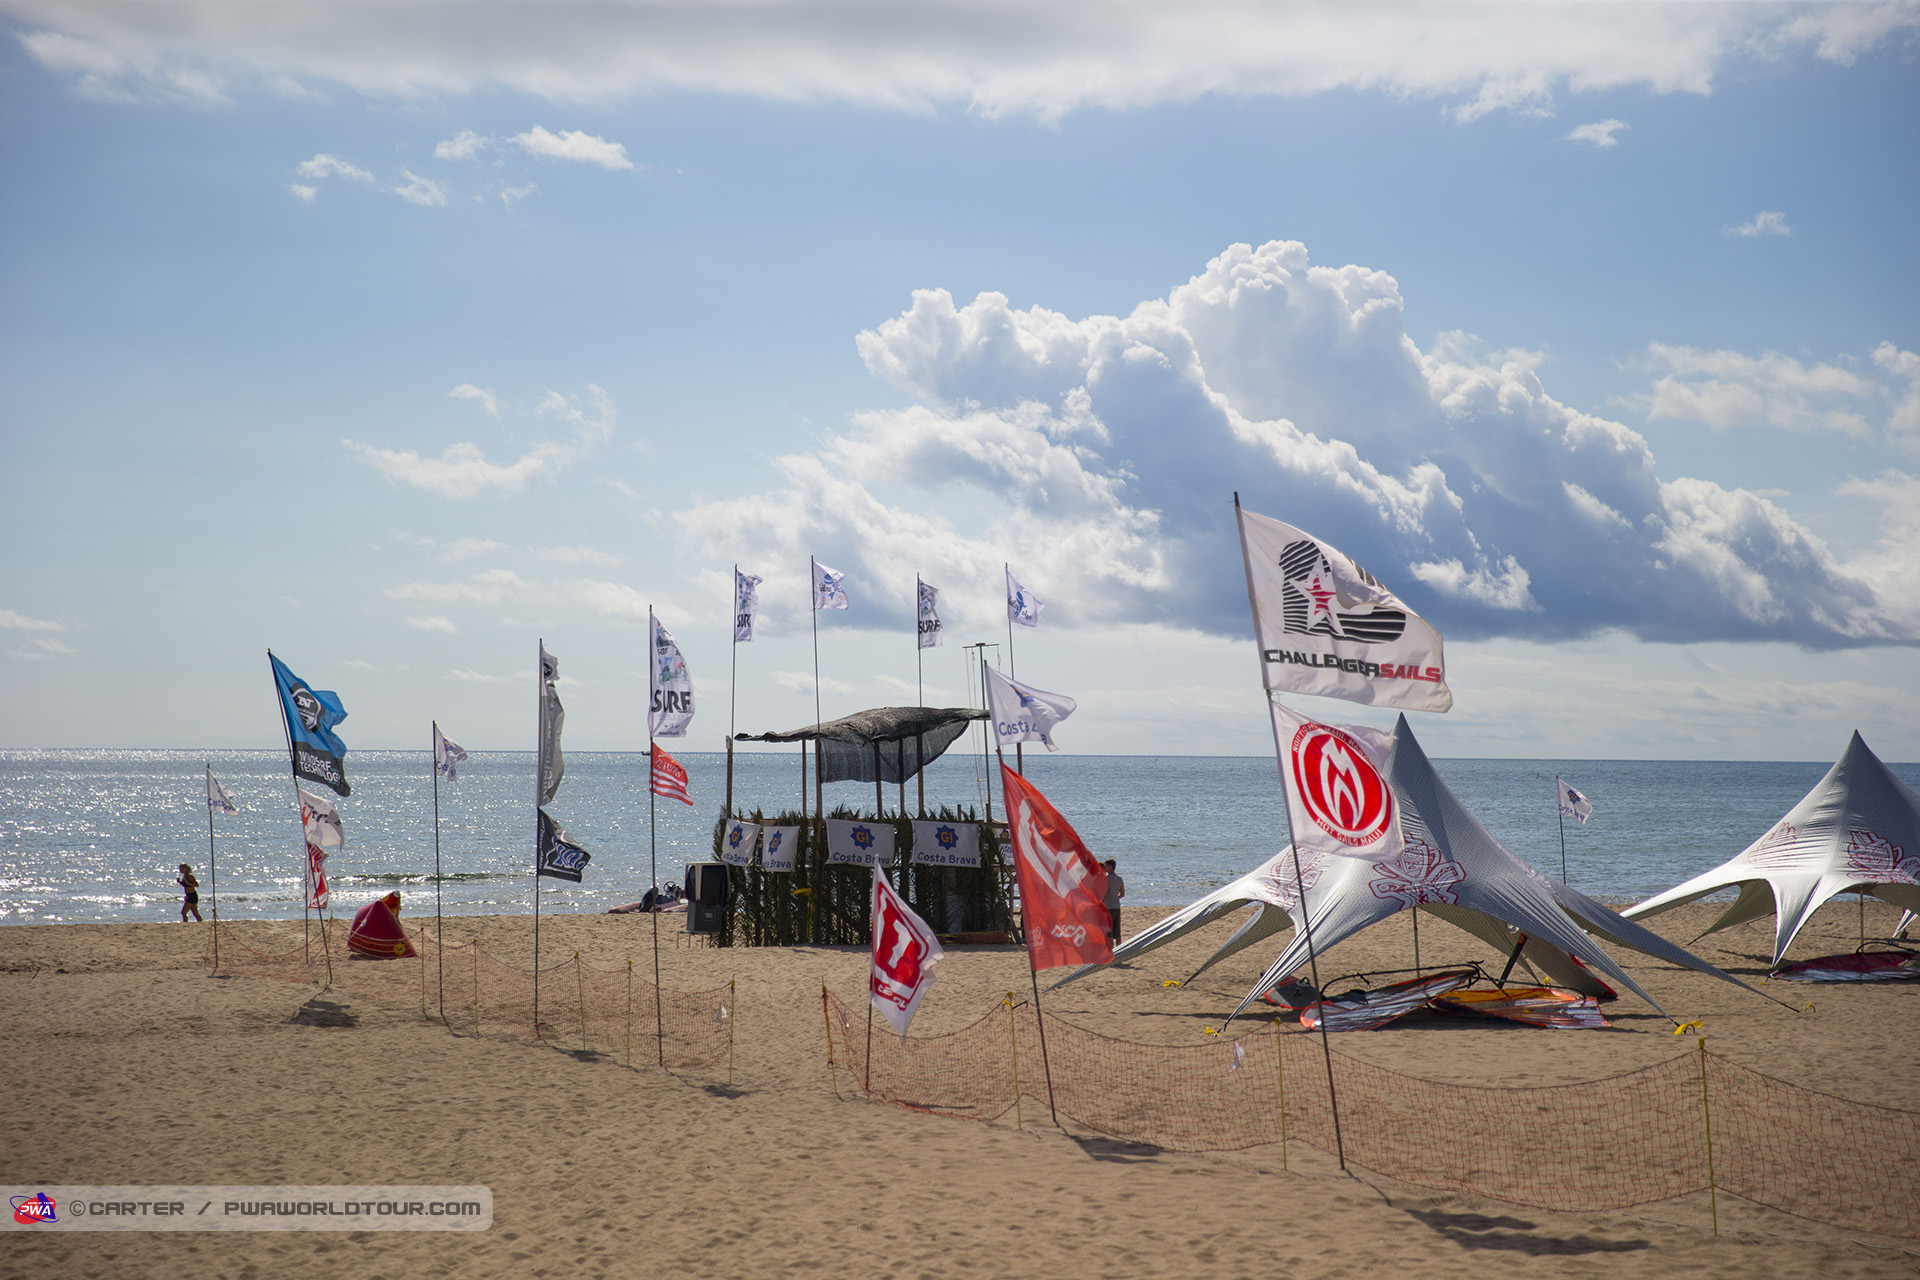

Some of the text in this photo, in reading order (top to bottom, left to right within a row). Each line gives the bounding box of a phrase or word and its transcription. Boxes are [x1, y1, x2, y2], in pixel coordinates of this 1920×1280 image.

[651, 689, 691, 713] SURF
[1361, 828, 1383, 846] MAUI
[770, 859, 792, 869] Brava
[833, 852, 863, 863] Costa
[917, 851, 977, 866] Costa Brava
